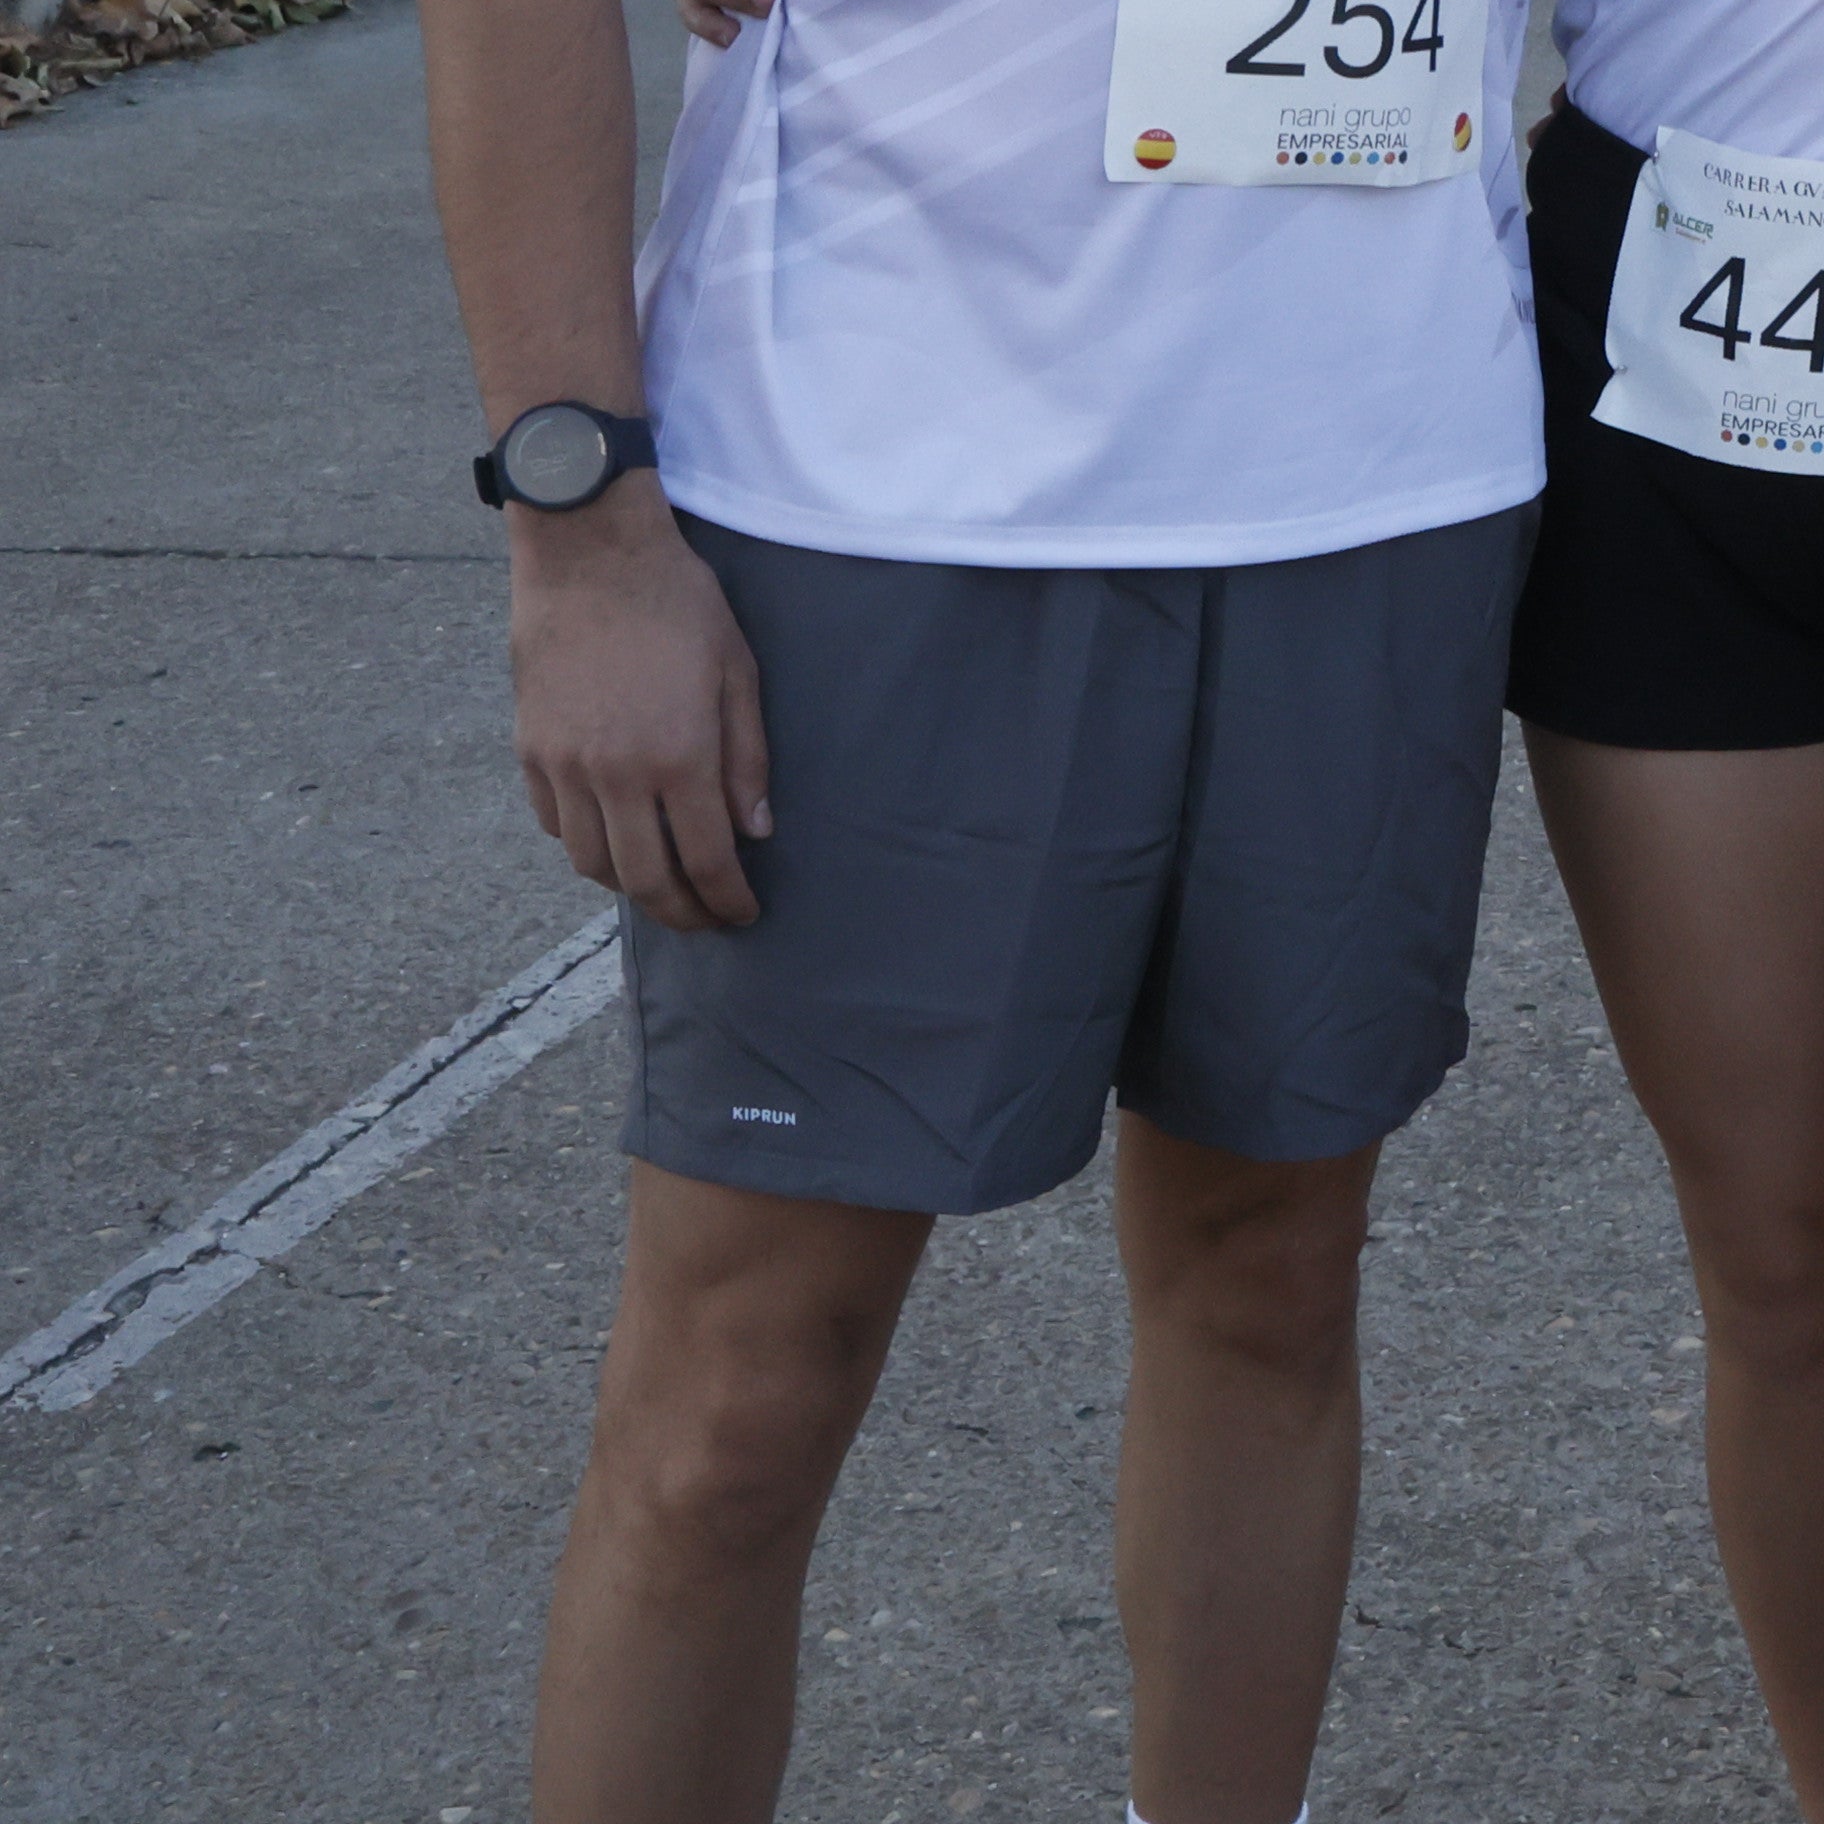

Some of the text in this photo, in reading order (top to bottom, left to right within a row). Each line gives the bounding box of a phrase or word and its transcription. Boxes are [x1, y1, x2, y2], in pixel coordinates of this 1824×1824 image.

[1278, 102, 1411, 134] nani grupo
[1277, 132, 1409, 151] EMPRESARIAL
[1703, 161, 1788, 195] CARRERA
[1721, 389, 1778, 413] nani
[731, 1106, 797, 1126] KIPRUN
